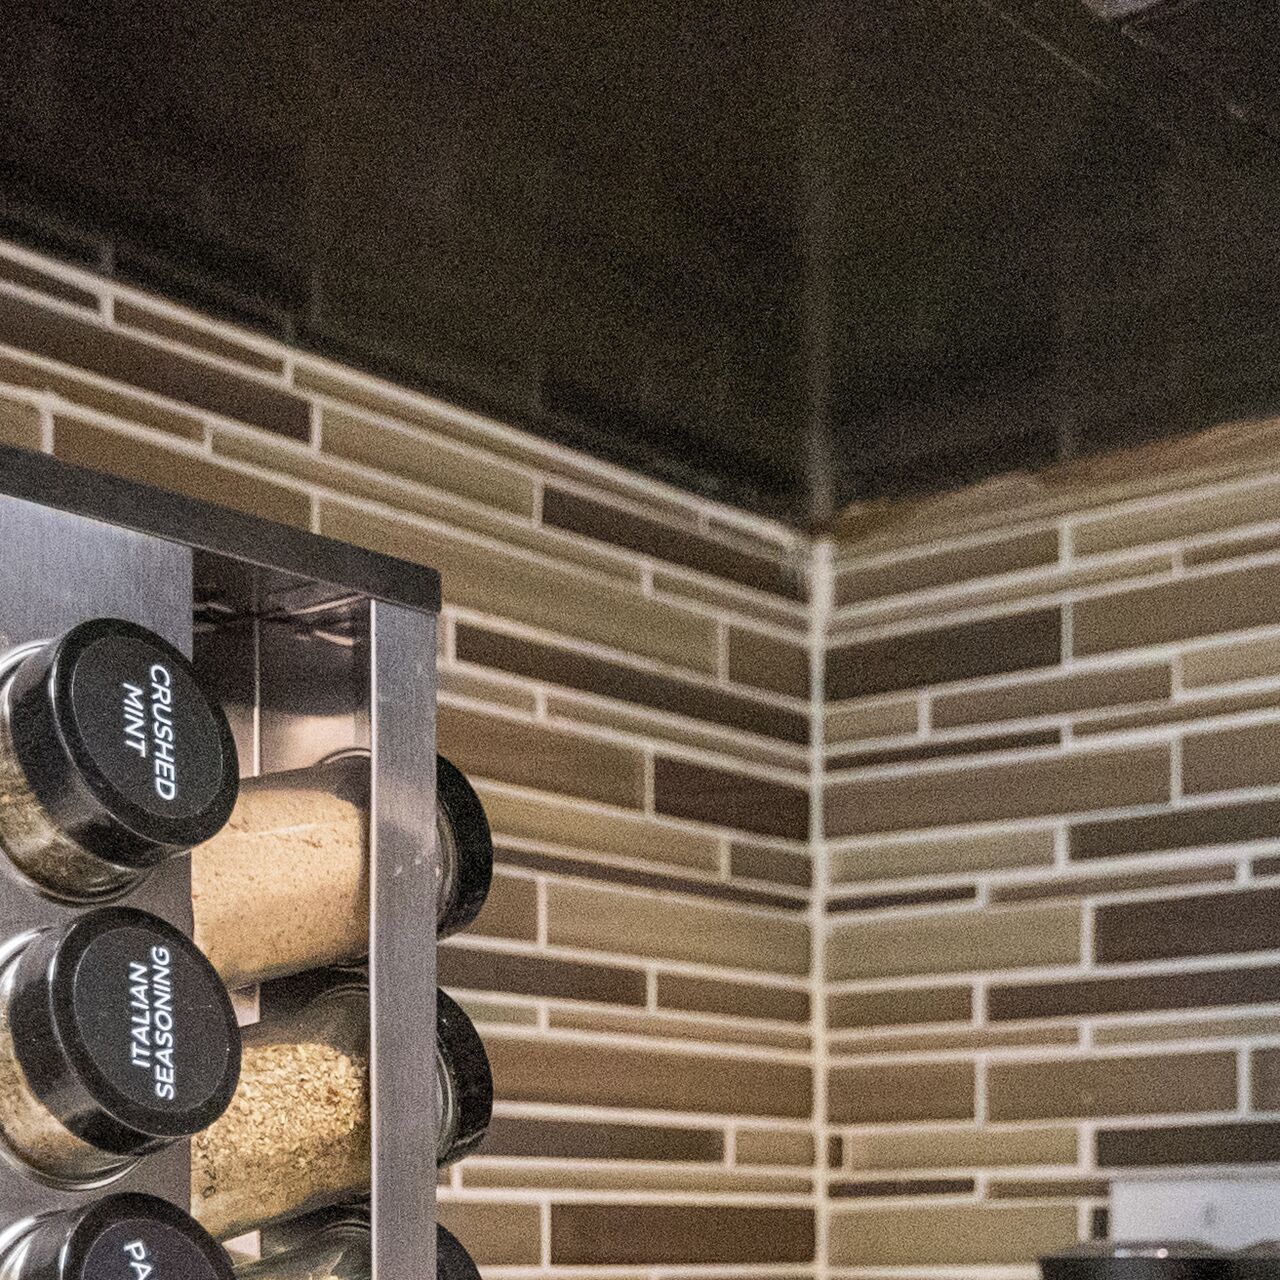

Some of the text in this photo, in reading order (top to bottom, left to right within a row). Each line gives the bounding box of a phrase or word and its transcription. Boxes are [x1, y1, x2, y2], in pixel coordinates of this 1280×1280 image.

[122, 683, 146, 757] MINT
[150, 664, 176, 800] CRUSHED
[130, 961, 154, 1068] ITALIAN
[153, 947, 174, 1100] SEASONING
